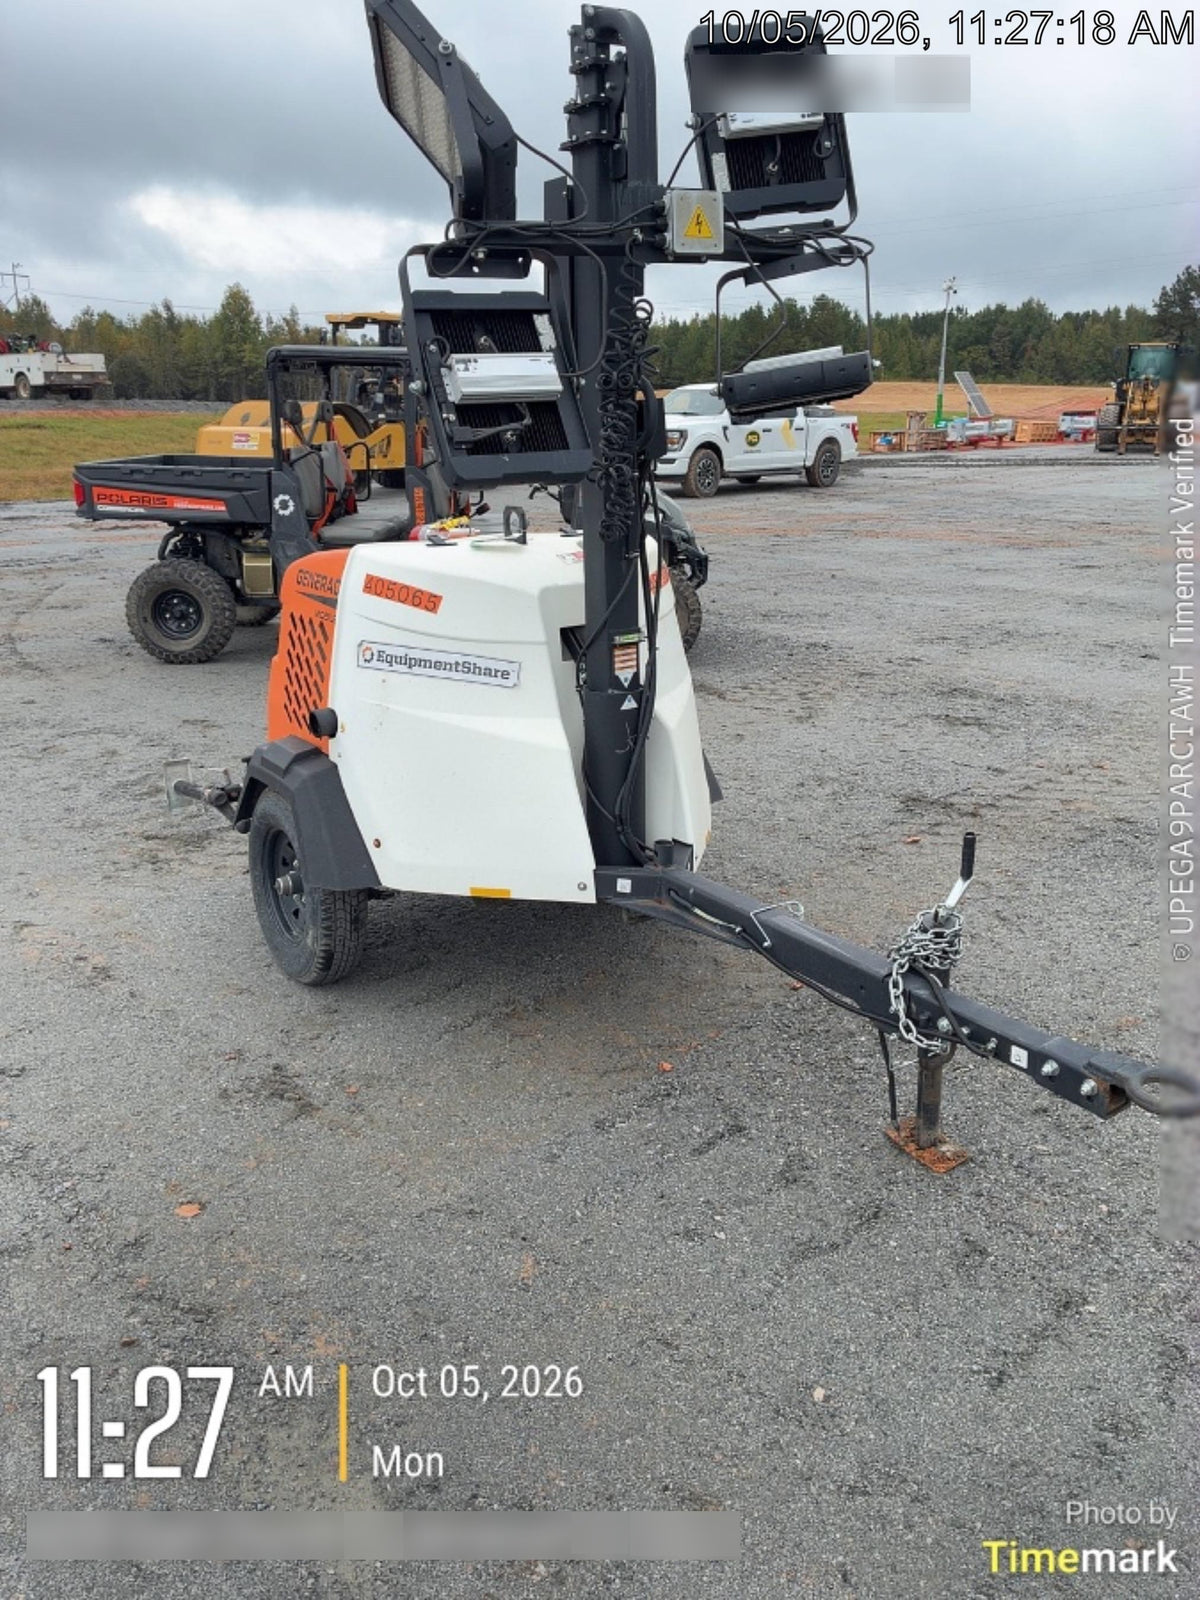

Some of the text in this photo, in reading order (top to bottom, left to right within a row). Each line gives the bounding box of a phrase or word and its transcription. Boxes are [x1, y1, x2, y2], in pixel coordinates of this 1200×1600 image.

[97, 493, 168, 506] POLARIS
[364, 575, 438, 612] 405065
[376, 650, 511, 680] EquipmentShare
